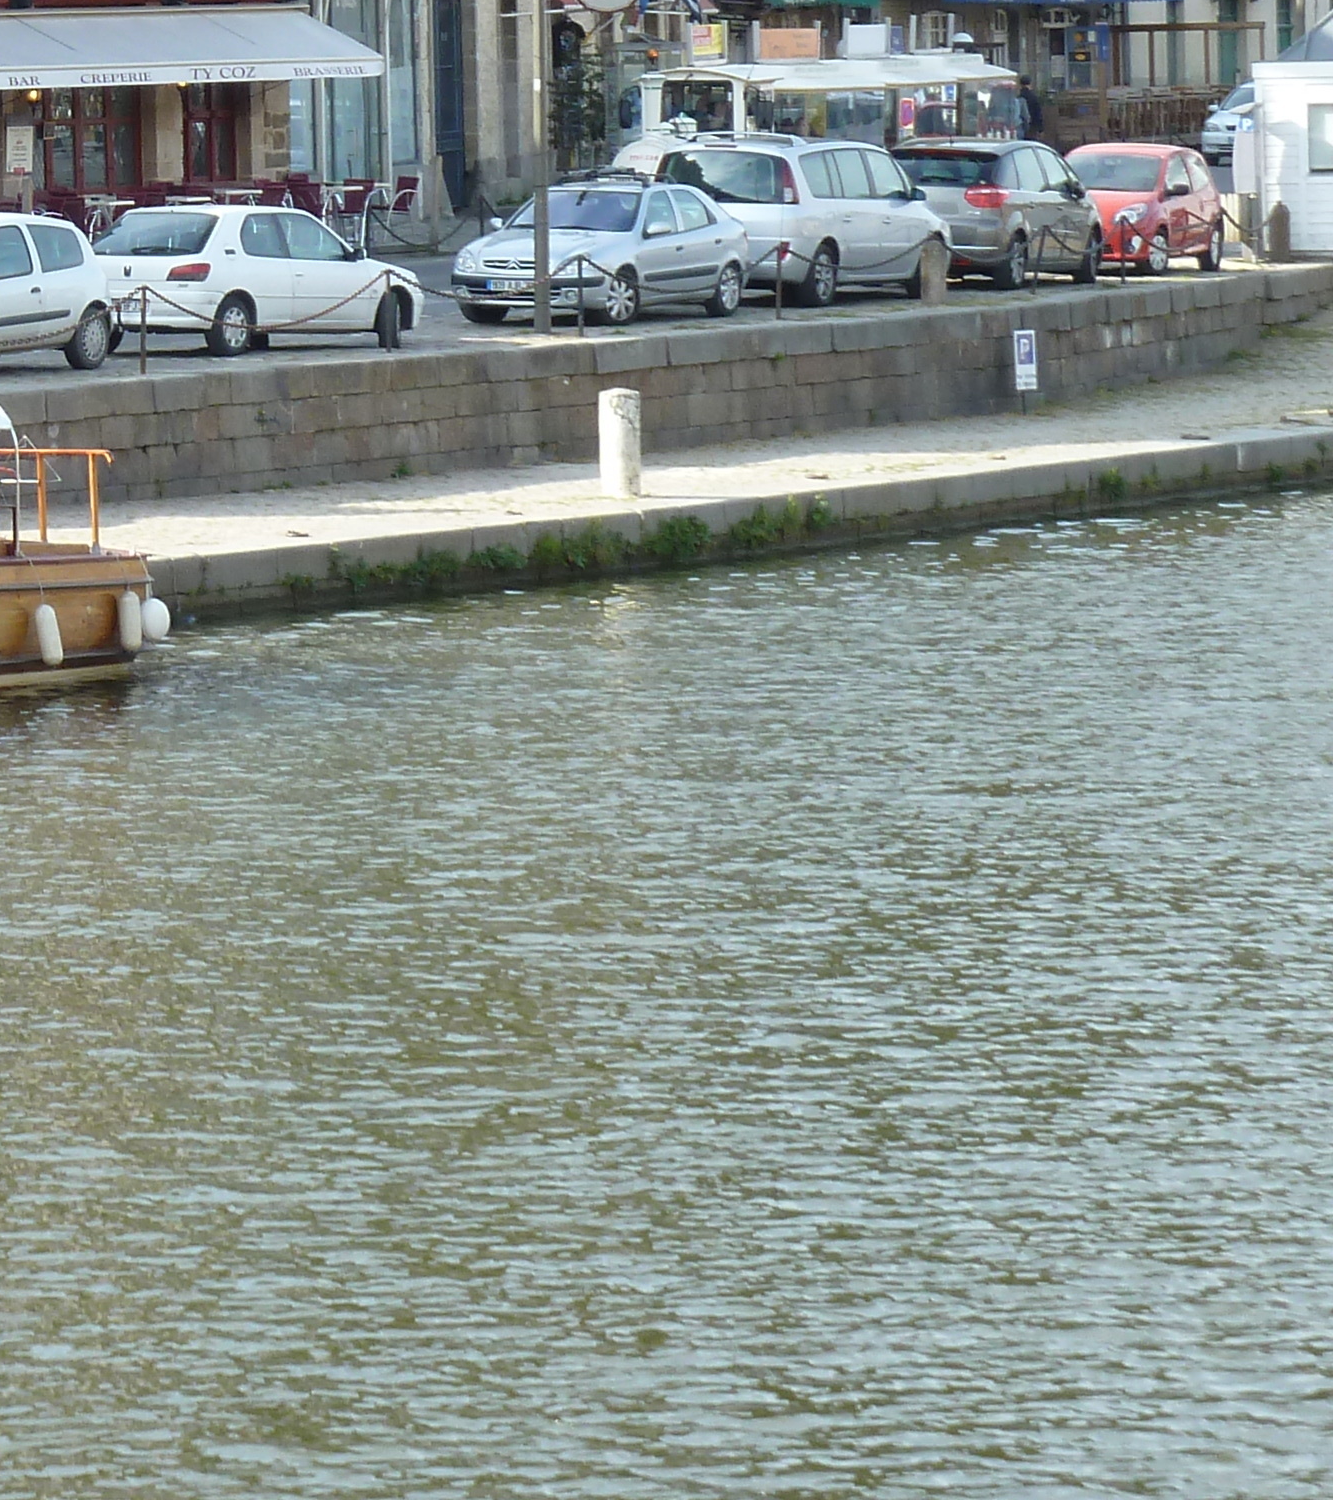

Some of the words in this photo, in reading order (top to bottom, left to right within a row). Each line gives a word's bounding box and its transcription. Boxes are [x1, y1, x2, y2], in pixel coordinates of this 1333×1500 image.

[8, 75, 41, 88] BAR
[79, 72, 152, 85] CREPERIE
[190, 68, 212, 80] TY
[219, 66, 256, 80] COZ
[293, 64, 368, 78] BRASSERIE
